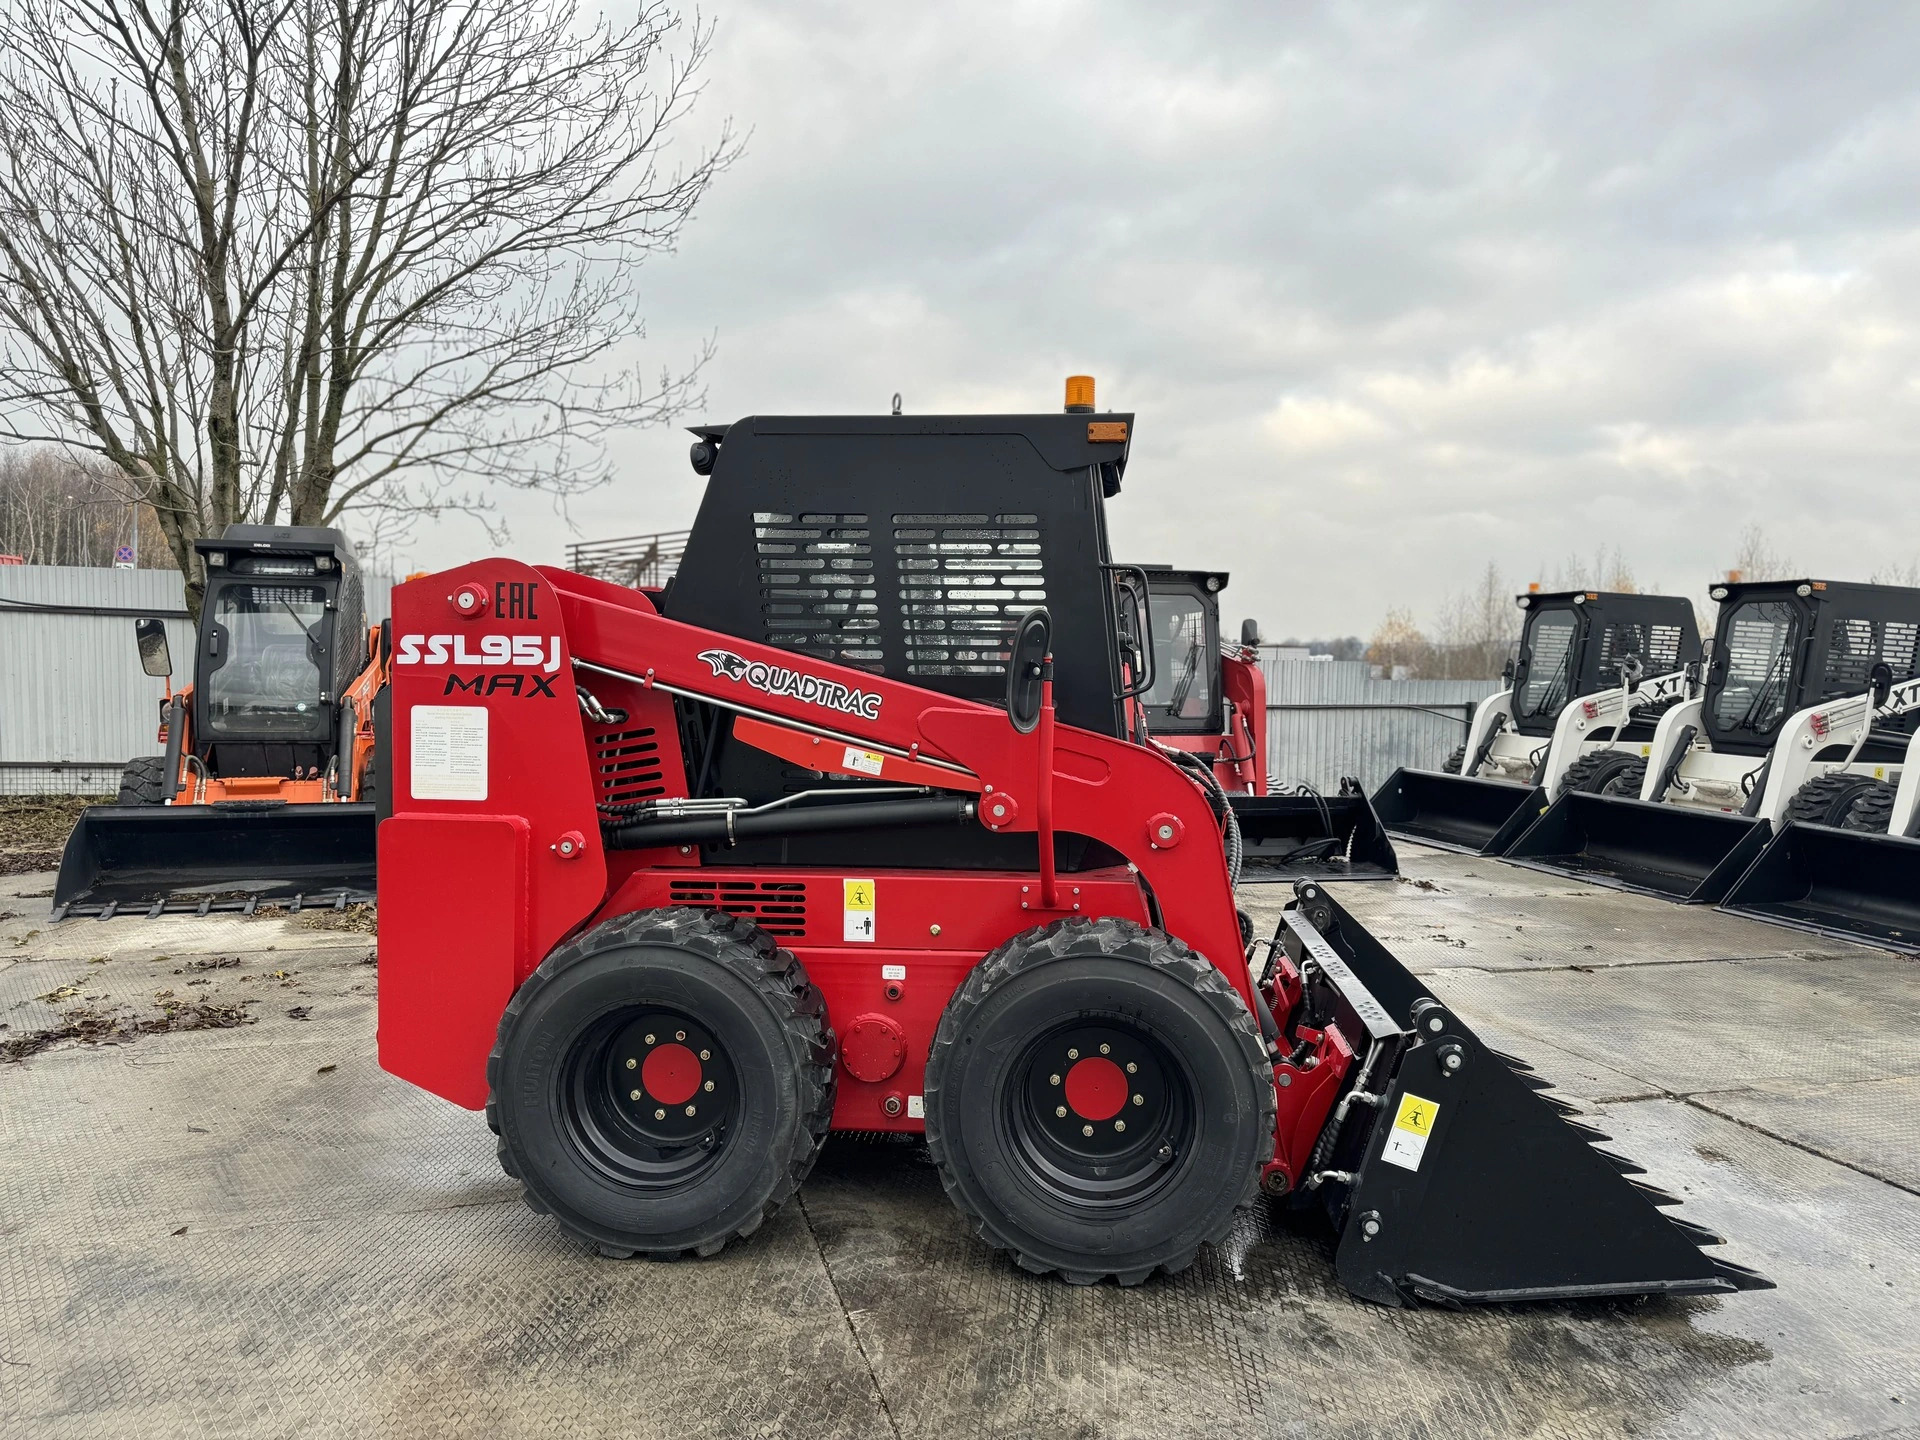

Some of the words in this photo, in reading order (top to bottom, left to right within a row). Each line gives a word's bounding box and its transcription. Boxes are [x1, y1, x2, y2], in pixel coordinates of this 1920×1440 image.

[495, 581, 538, 620] EAC
[396, 634, 561, 673] SSL95J
[443, 673, 561, 698] MAX
[747, 661, 883, 720] QUADTRAC
[1654, 676, 1681, 698] XT
[1891, 685, 1920, 709] XT
